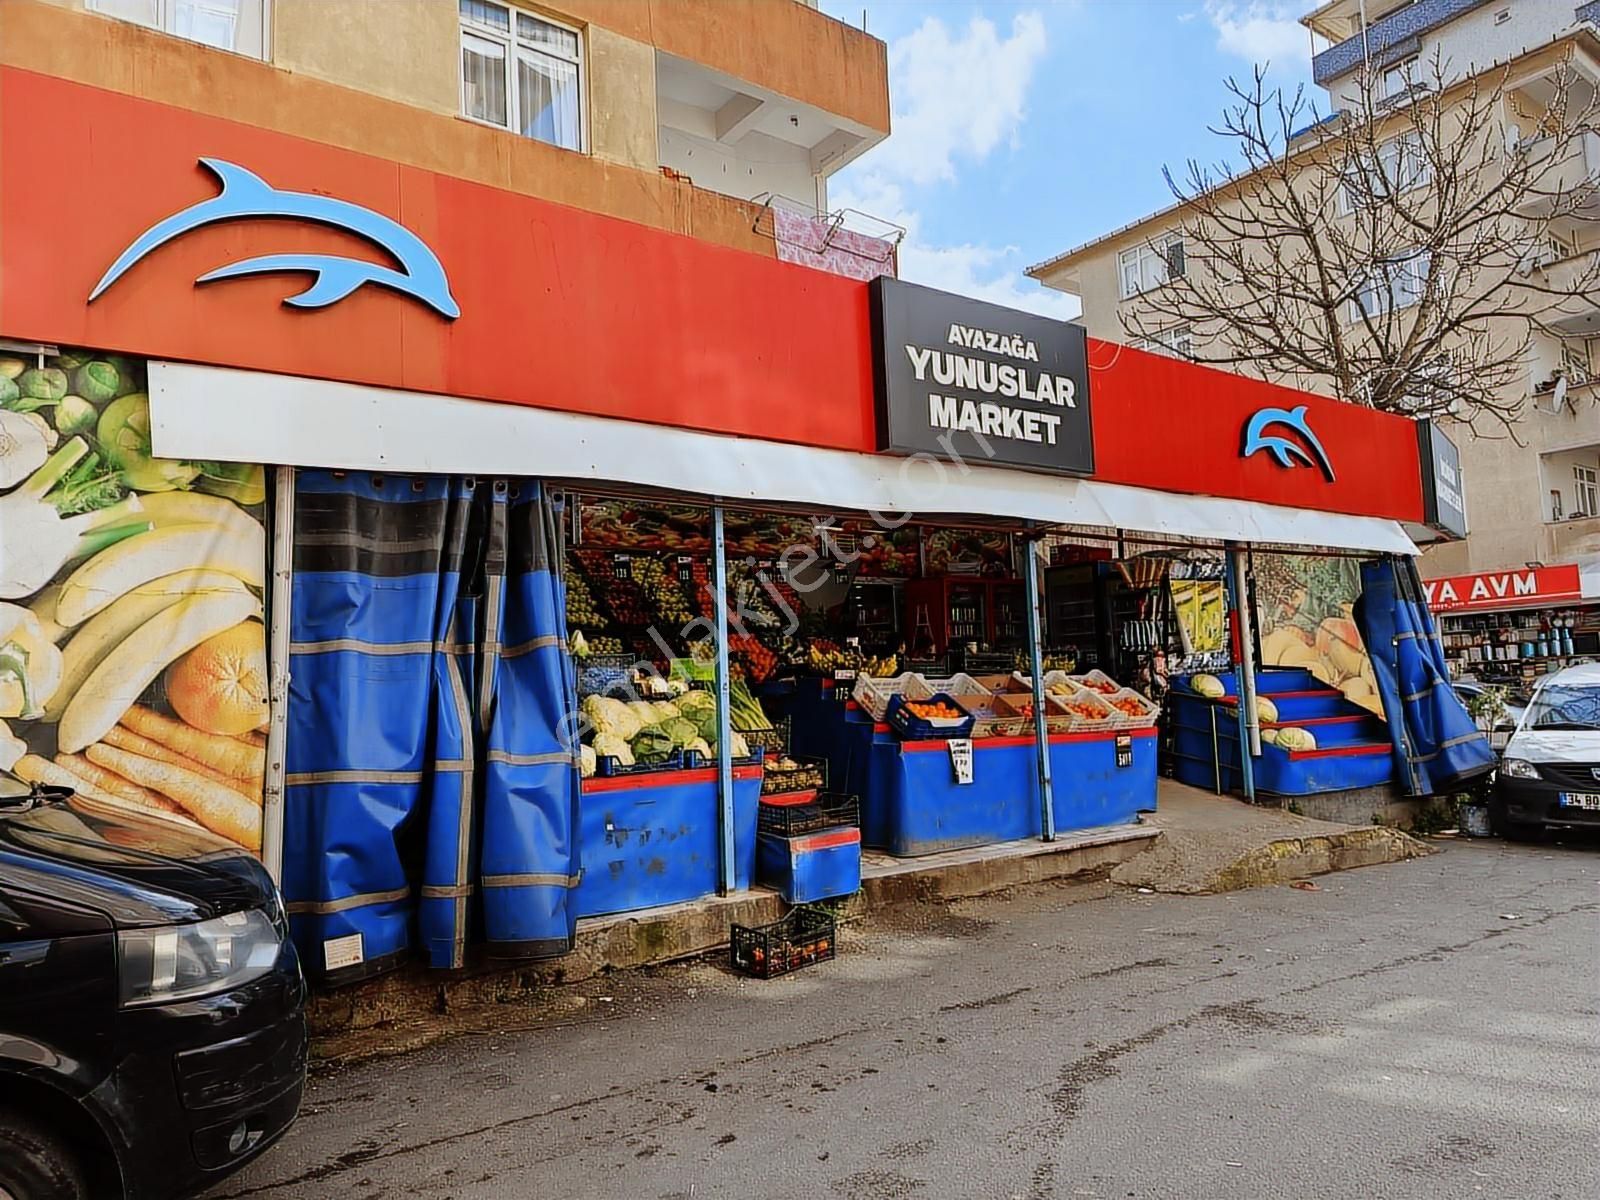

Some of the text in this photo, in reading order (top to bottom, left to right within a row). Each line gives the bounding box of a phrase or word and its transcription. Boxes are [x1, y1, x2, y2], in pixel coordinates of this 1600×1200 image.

[948, 324, 1039, 362] AYAZAĞA
[905, 344, 1076, 408] YUNUSLAR
[928, 393, 1061, 445] MARKET
[1421, 572, 1537, 604] YA AVM
